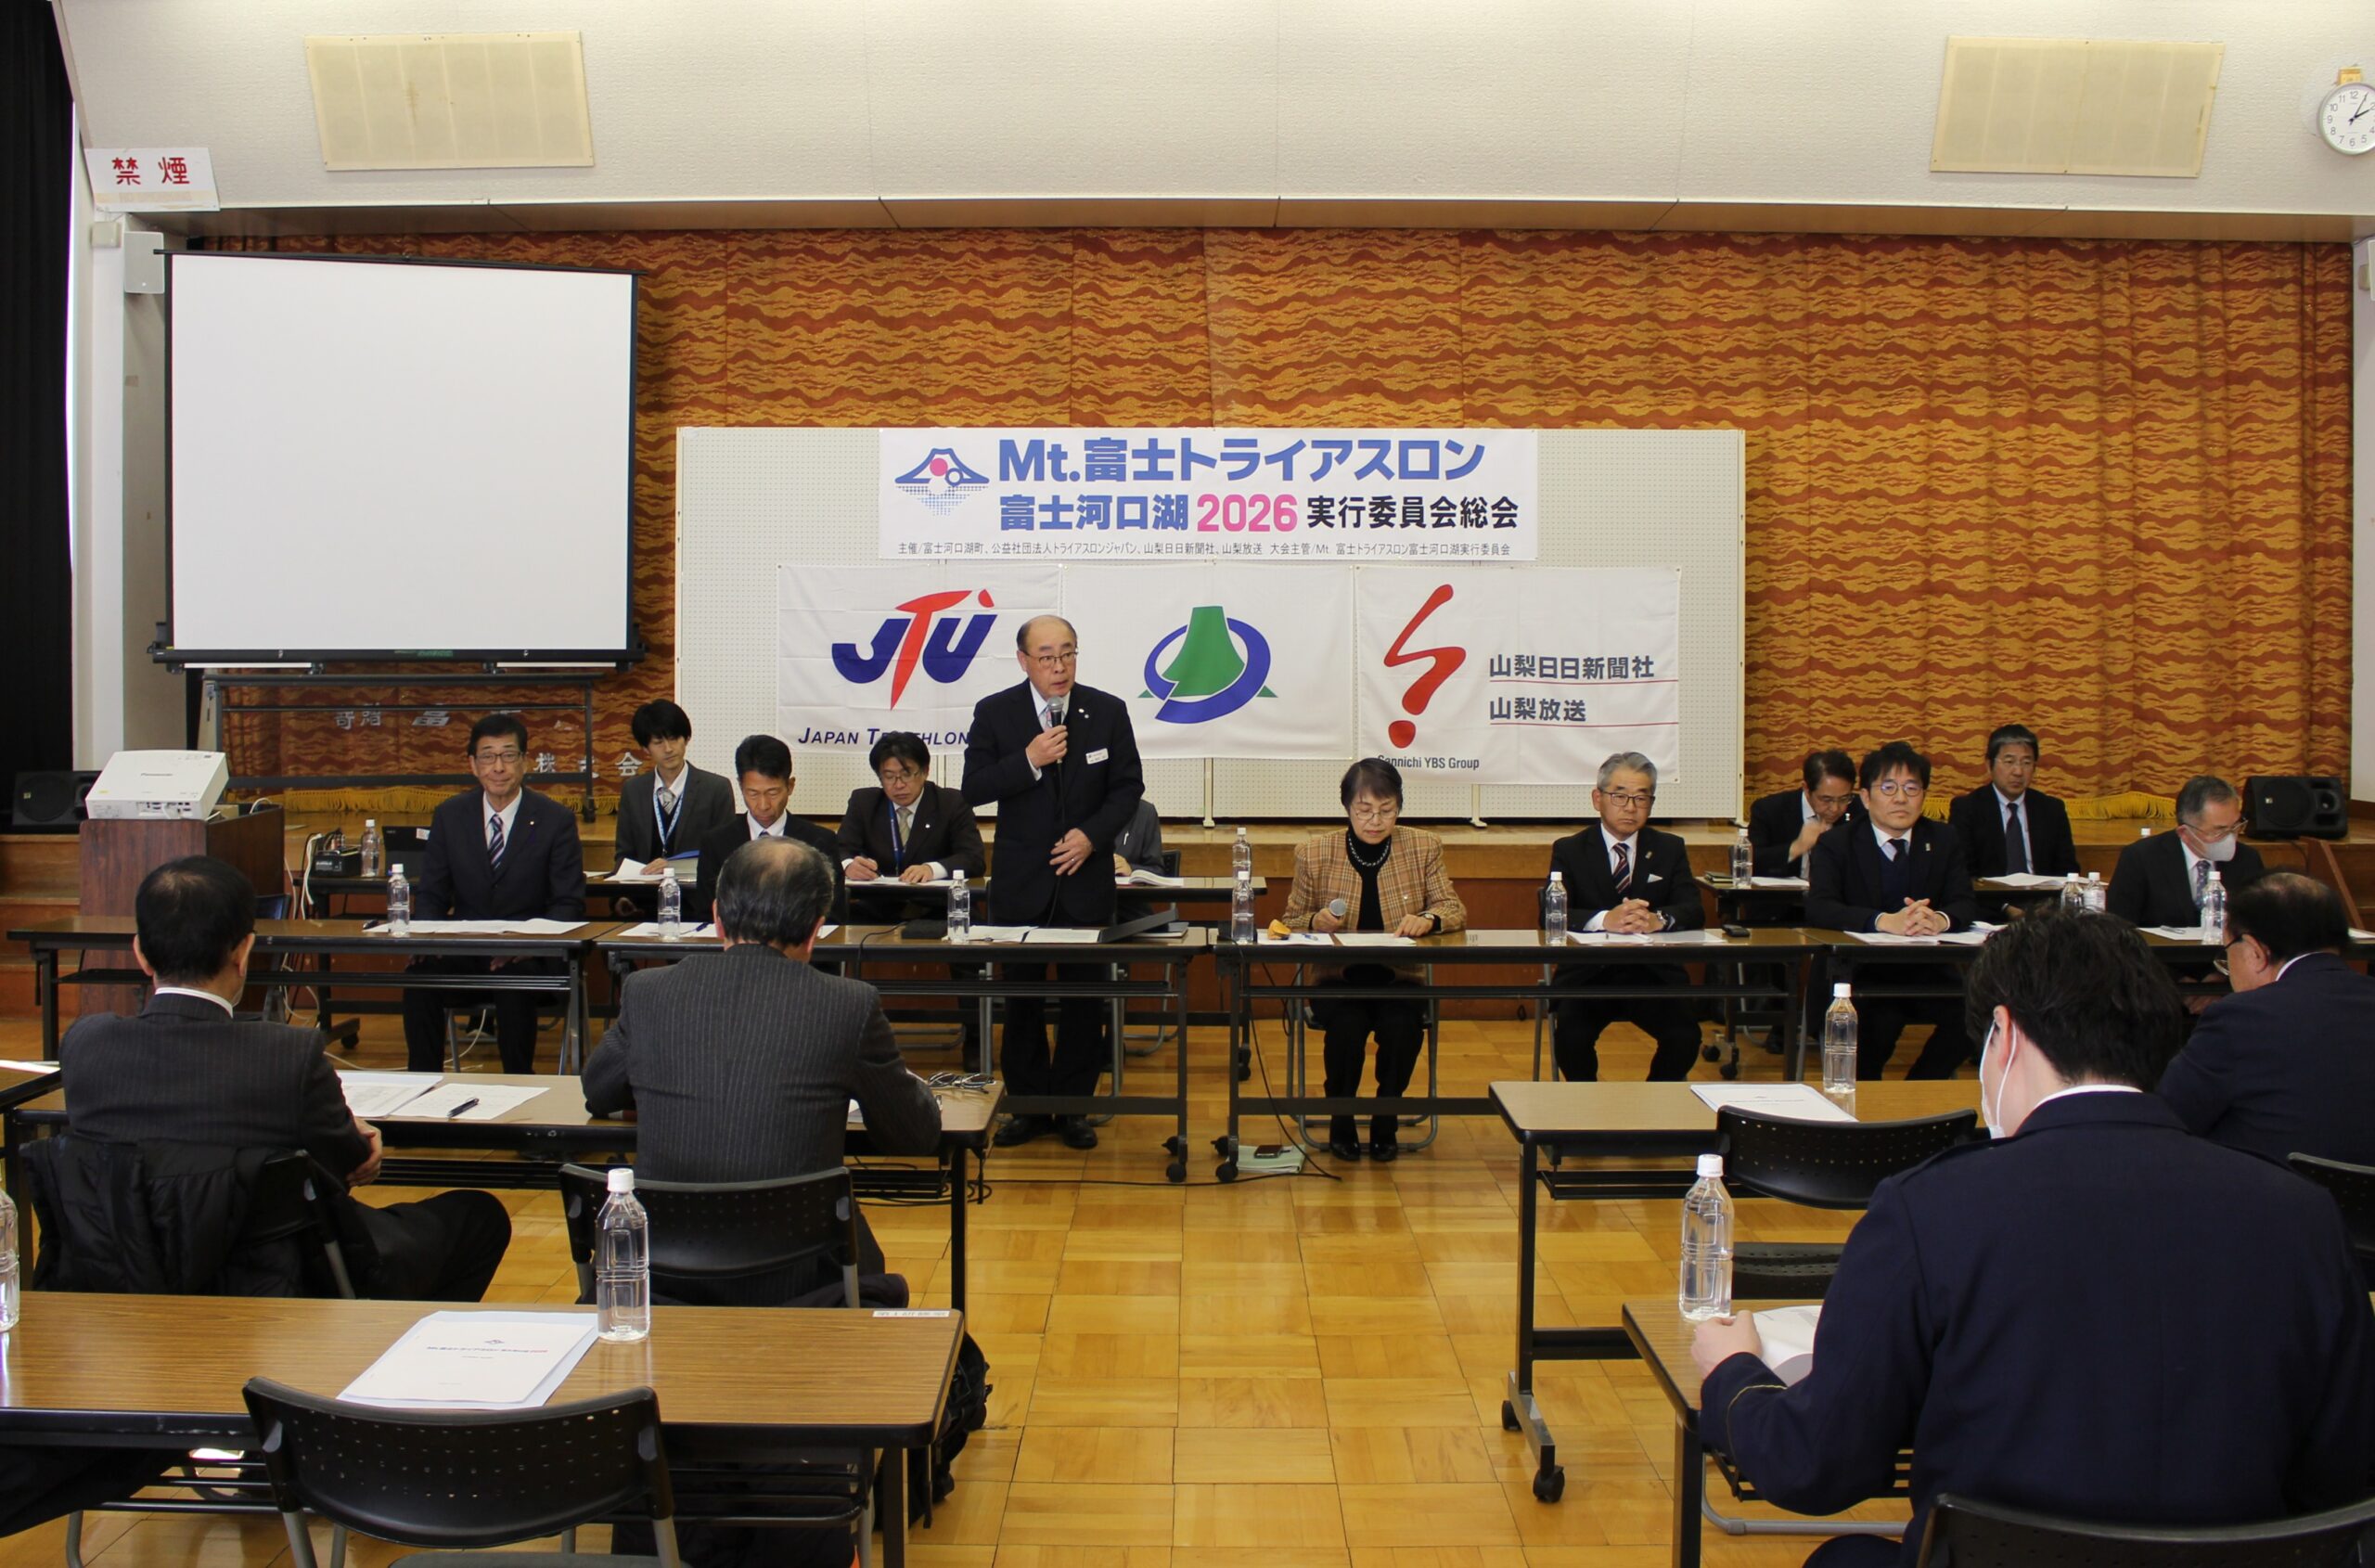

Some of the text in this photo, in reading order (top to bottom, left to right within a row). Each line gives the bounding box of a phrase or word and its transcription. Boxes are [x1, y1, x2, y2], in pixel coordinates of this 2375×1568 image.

[2339, 95, 2345, 103] 11
[2350, 91, 2359, 99] 12
[2330, 103, 2338, 112] 10
[111, 157, 190, 186] 禁煙
[999, 437, 1485, 482] Mt.富士トライアスロン
[1307, 495, 1519, 529] 実行委員会総会
[1489, 654, 1655, 679] 山梨日日新聞社
[1489, 697, 1586, 722] 山梨放送
[798, 727, 969, 745] JAPAN THLON
[1424, 757, 1445, 769] YBS
[1448, 757, 1480, 771] Group
